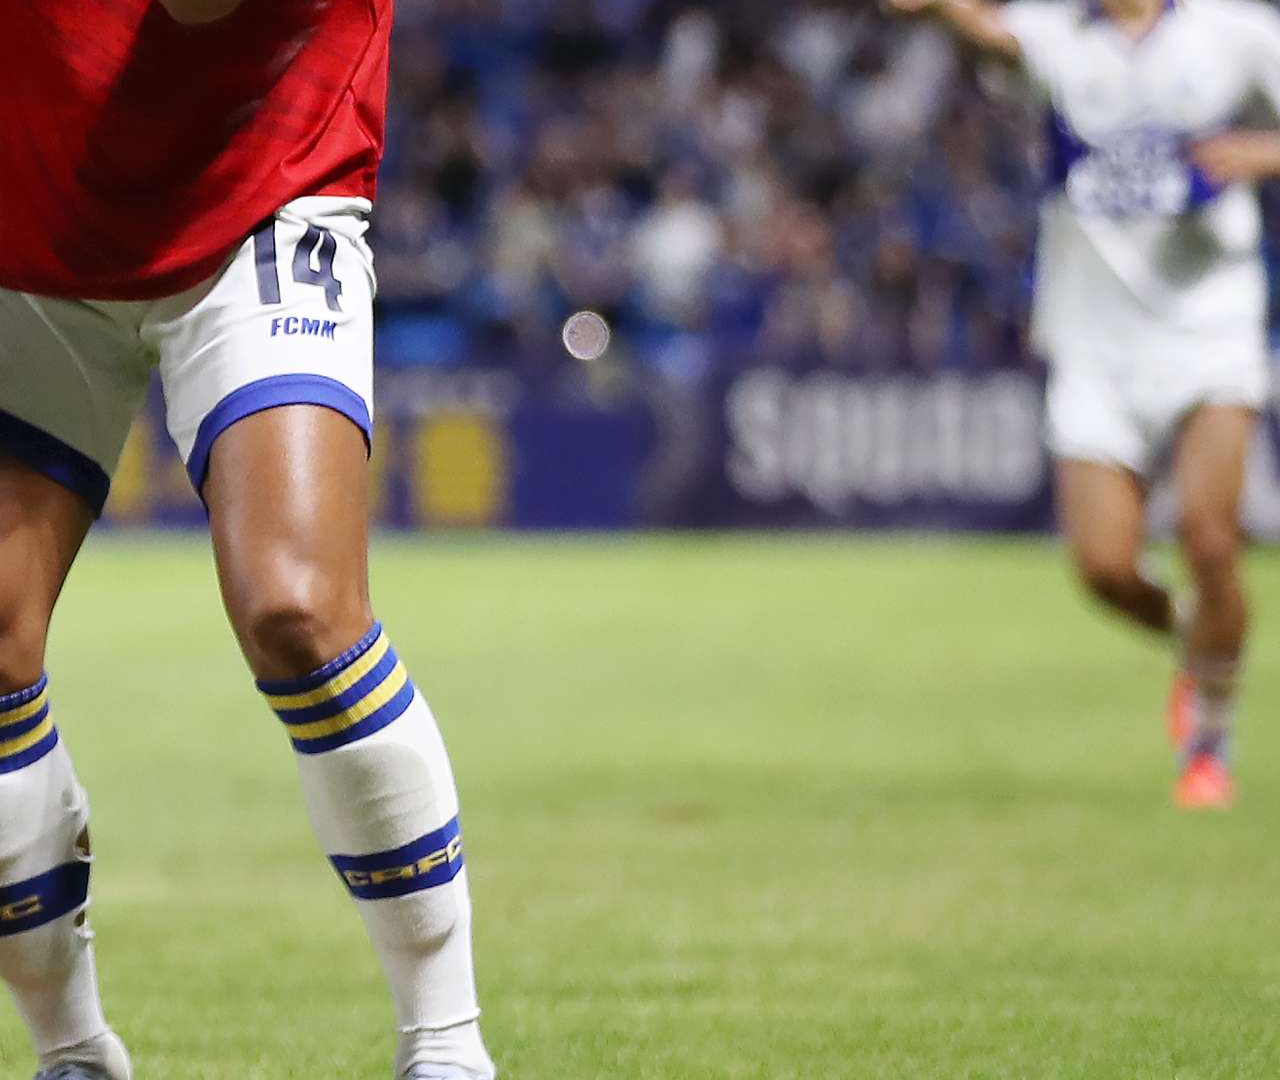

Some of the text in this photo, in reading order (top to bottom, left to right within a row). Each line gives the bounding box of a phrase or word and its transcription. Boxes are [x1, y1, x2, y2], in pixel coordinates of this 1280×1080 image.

[253, 223, 344, 313] 14
[270, 316, 337, 340] FCMM
[343, 833, 462, 887] CAFC
